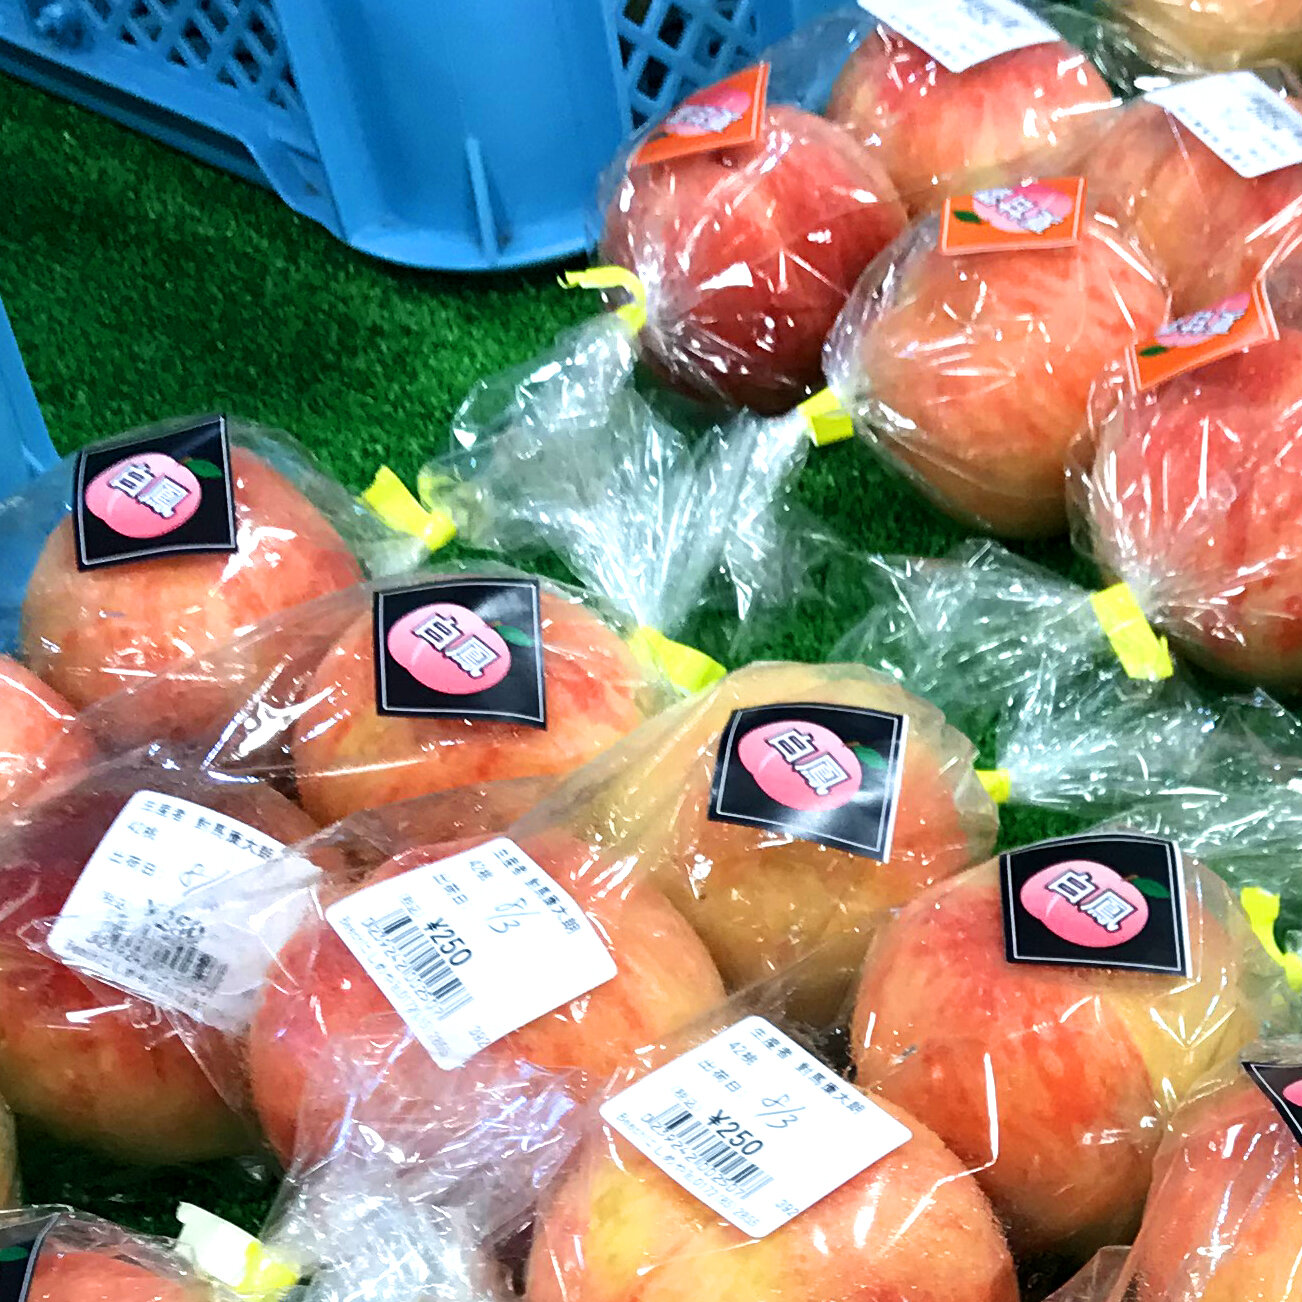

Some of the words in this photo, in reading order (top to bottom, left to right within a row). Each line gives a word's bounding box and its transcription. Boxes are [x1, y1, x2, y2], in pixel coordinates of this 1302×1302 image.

[108, 462, 193, 519] 白鳳
[412, 612, 500, 679] 白鳳
[763, 727, 851, 796] 白鳳
[1050, 868, 1138, 933] 白鳳
[424, 917, 474, 967] ¥250
[706, 1109, 764, 1157] ¥250
[755, 1094, 806, 1129] 8/3
